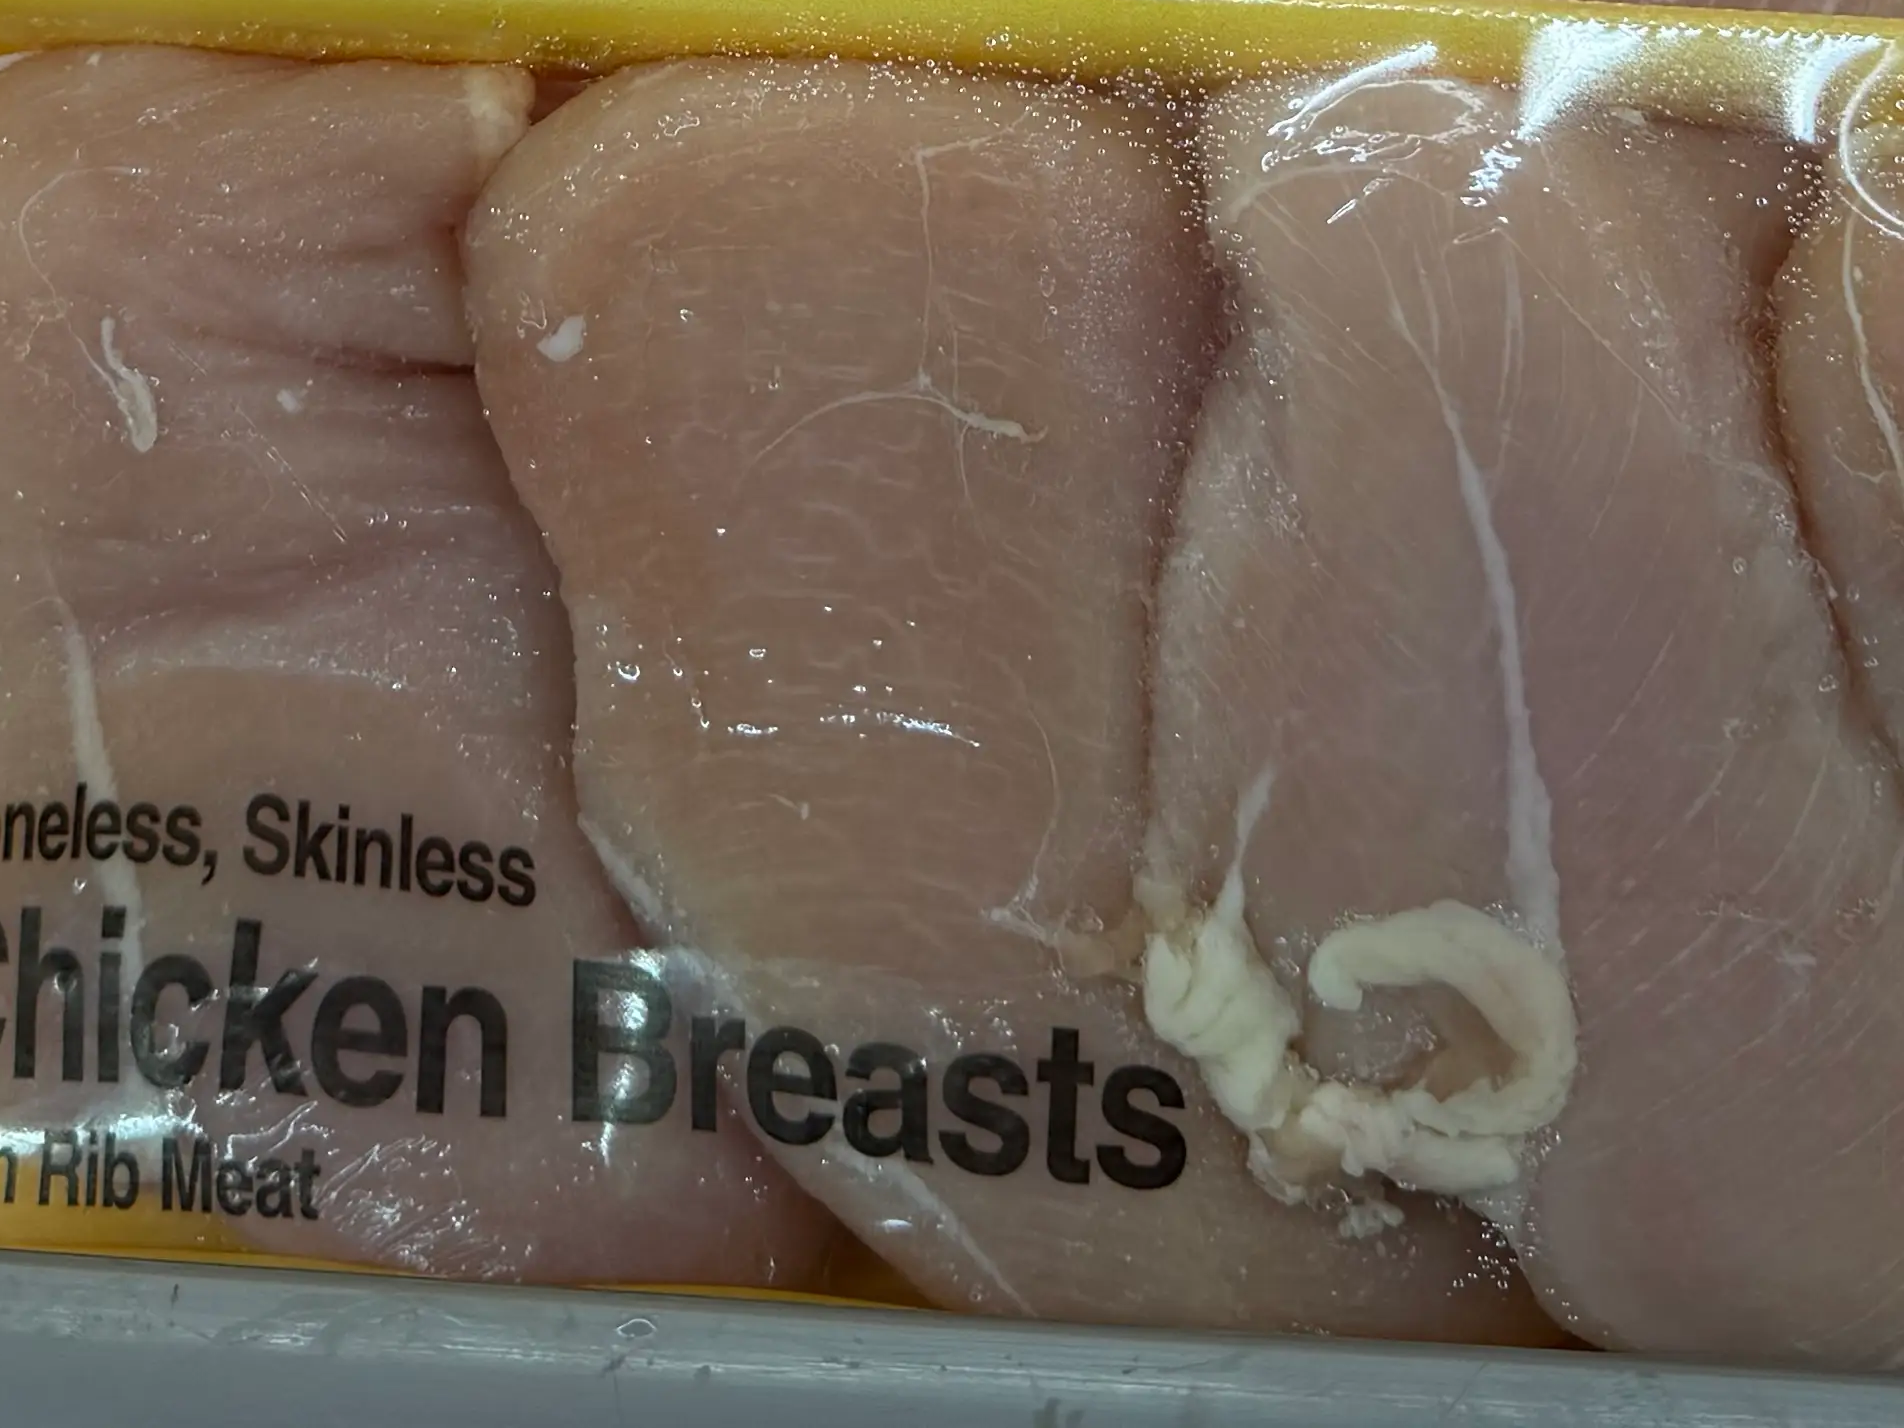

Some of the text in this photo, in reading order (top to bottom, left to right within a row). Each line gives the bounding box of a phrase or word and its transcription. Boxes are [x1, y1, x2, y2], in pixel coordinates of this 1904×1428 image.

[244, 792, 538, 908] Skinless
[572, 958, 1191, 1193] Breasts
[38, 1128, 139, 1209] Rib
[160, 1135, 321, 1220] Meat
